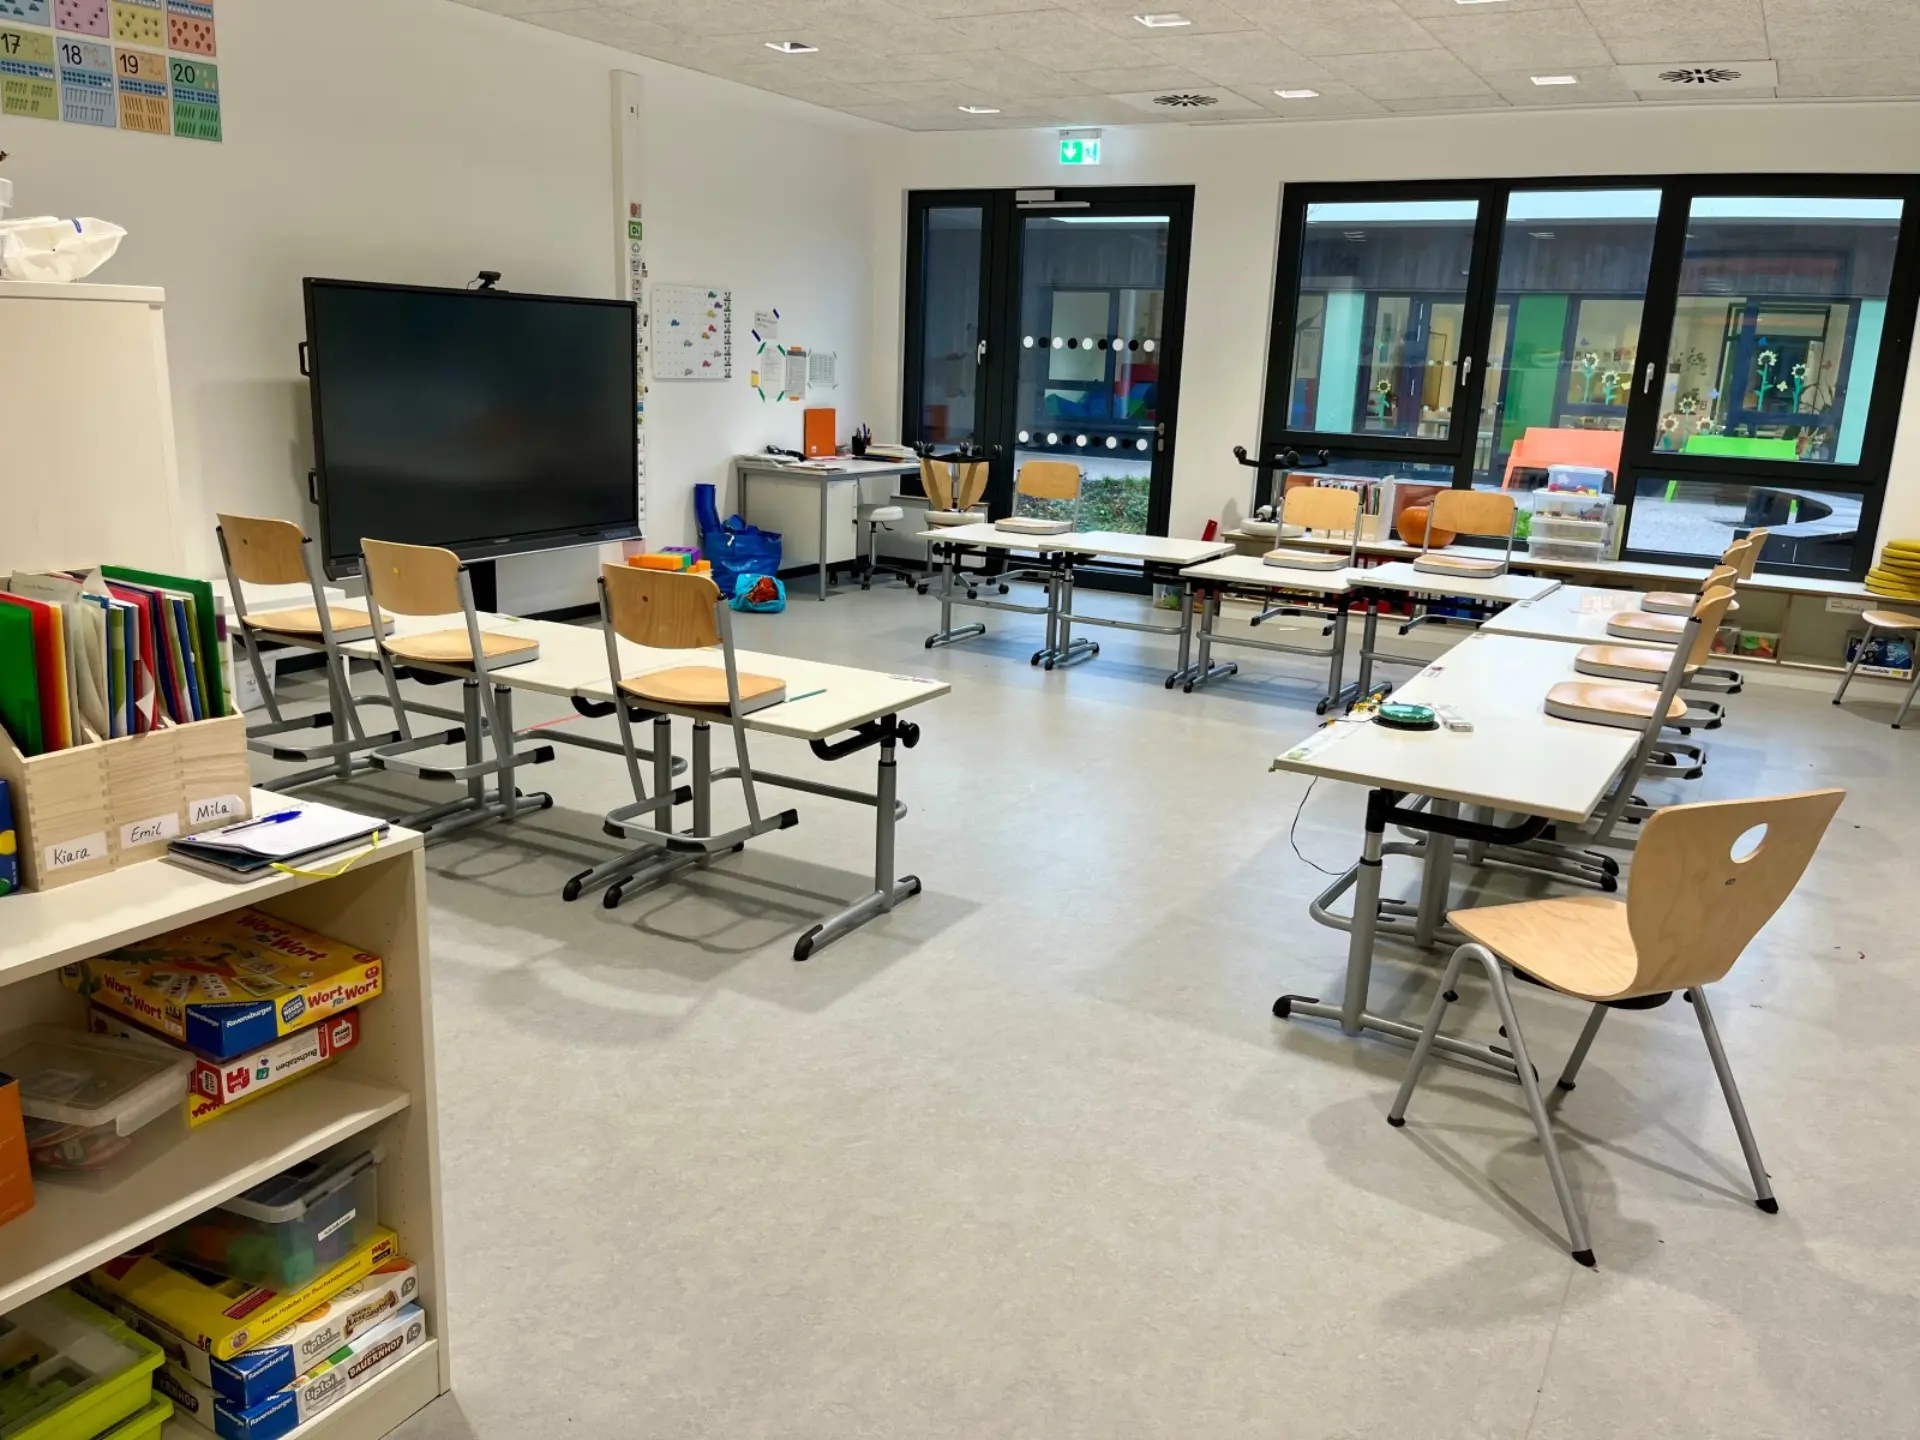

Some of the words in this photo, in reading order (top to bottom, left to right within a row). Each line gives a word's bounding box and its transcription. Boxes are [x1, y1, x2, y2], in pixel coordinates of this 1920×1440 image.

[1, 33, 20, 54] 17
[62, 44, 82, 65] 18
[120, 54, 138, 74] 19
[173, 63, 195, 83] 20
[195, 803, 230, 822] Mila
[131, 821, 163, 843] Emil
[53, 847, 90, 865] Kiara
[236, 915, 291, 936] Wort
[271, 937, 328, 962] Wort
[103, 973, 133, 998] Wort
[307, 984, 344, 1009] Wort
[344, 978, 378, 1000] Wort
[133, 995, 163, 1020] Wort
[332, 996, 346, 1008] für
[226, 1005, 273, 1028] Ravensburger
[275, 1048, 318, 1072] Buchstaben
[301, 1327, 332, 1355] tiptoi
[248, 1350, 290, 1380] Ravensburger
[349, 1337, 403, 1377] BAUERNHOF
[304, 1373, 336, 1400] tiptoi
[250, 1396, 293, 1426] Ravensburger
